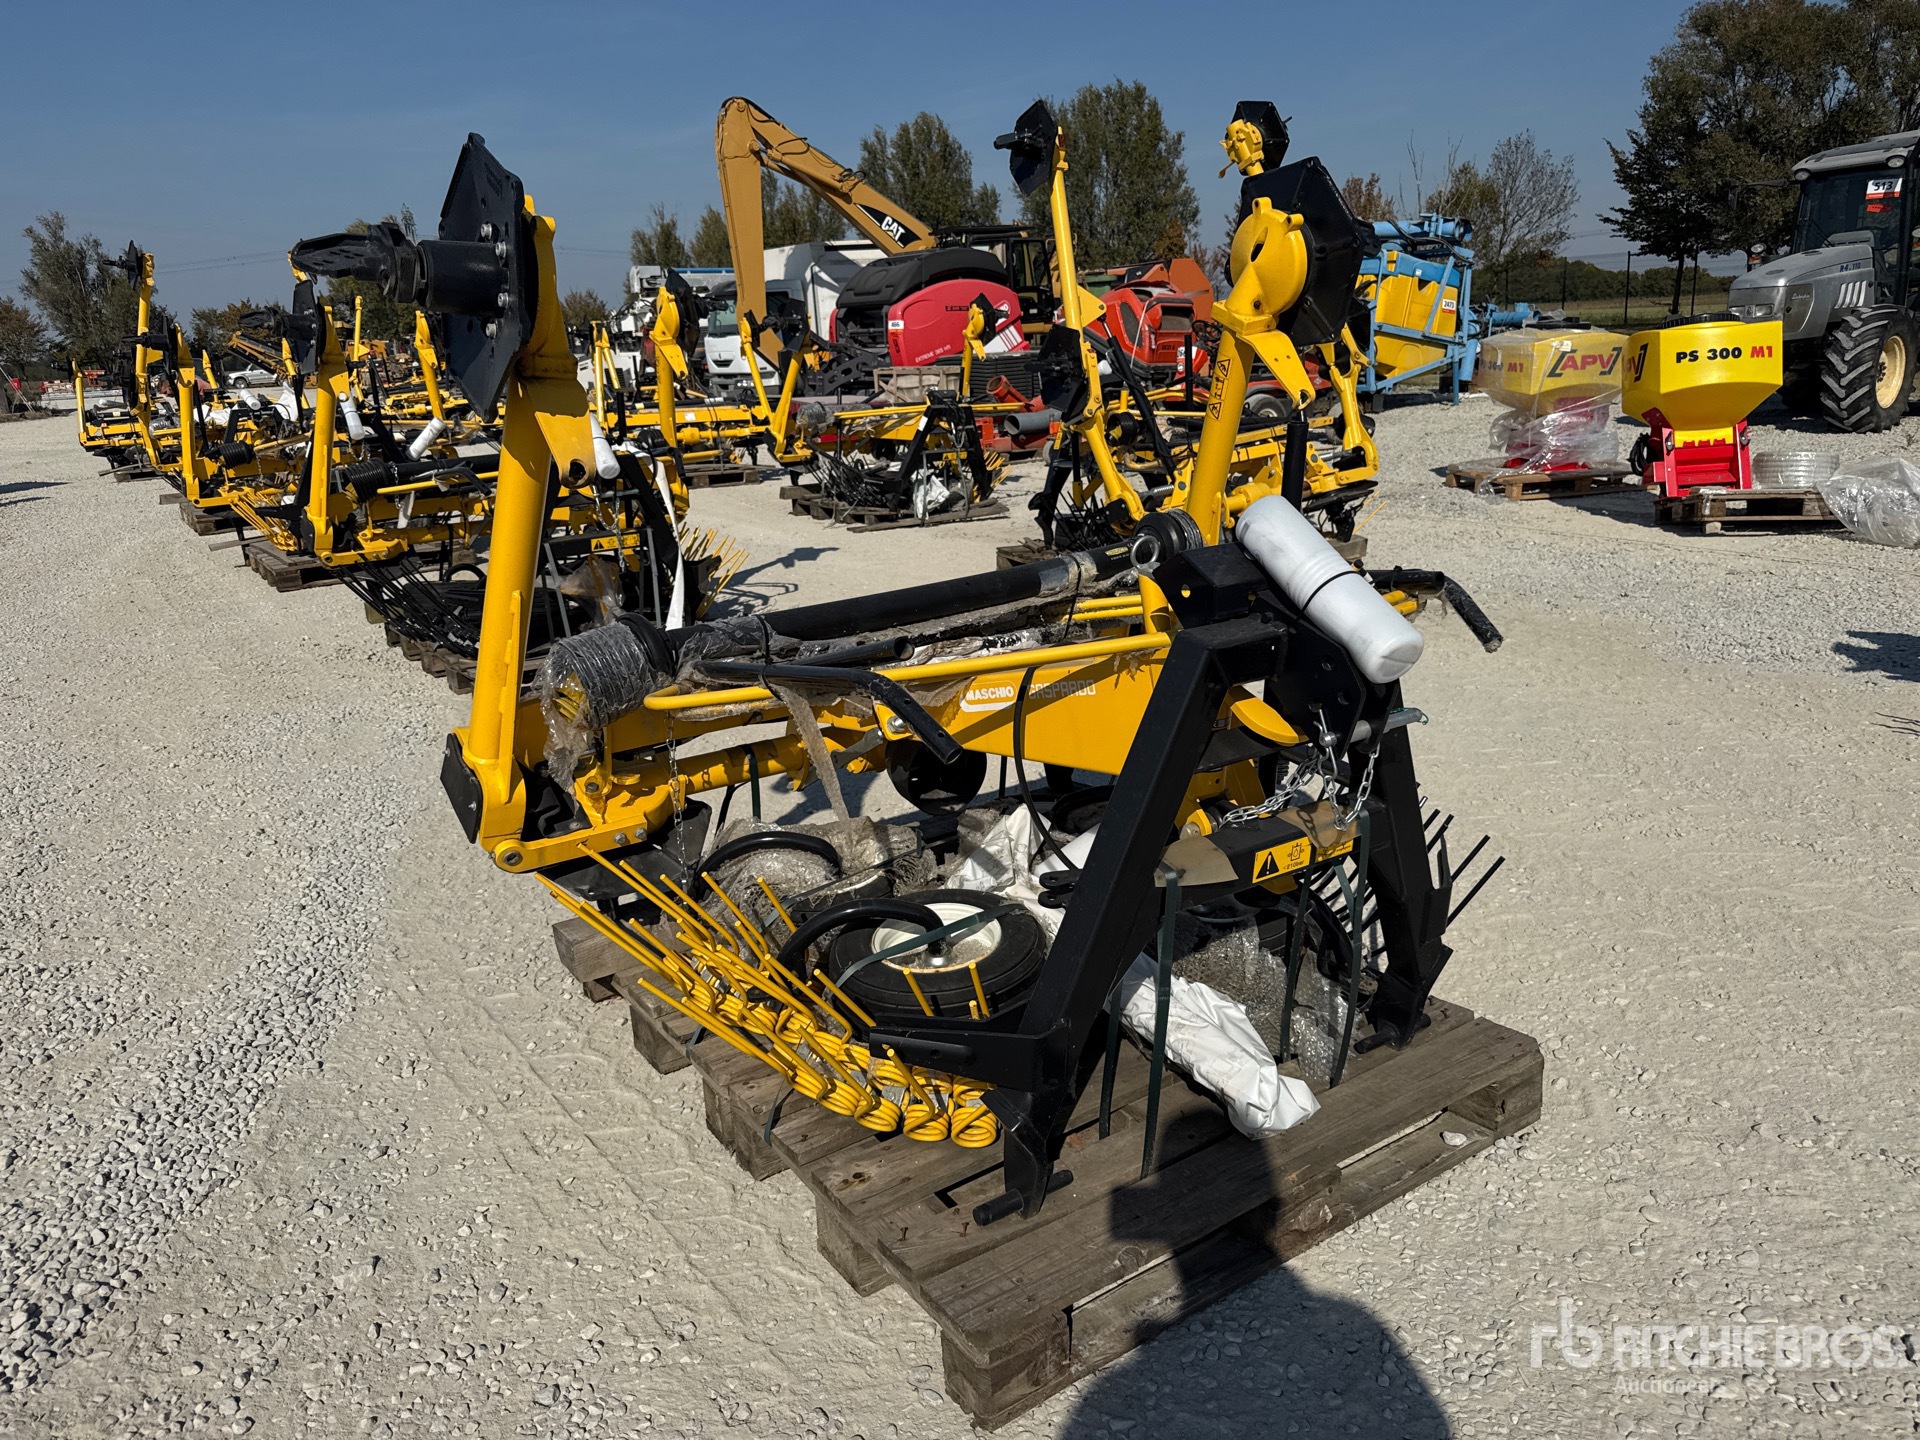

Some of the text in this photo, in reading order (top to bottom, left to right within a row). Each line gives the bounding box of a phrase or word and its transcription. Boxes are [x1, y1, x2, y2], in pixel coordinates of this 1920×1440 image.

[1873, 181, 1894, 191] 513
[881, 216, 906, 241] CAT
[1675, 345, 1773, 363] PS 300 M1
[1507, 362, 1524, 373] M1
[966, 679, 1097, 701] MASCHIO GASPARDO
